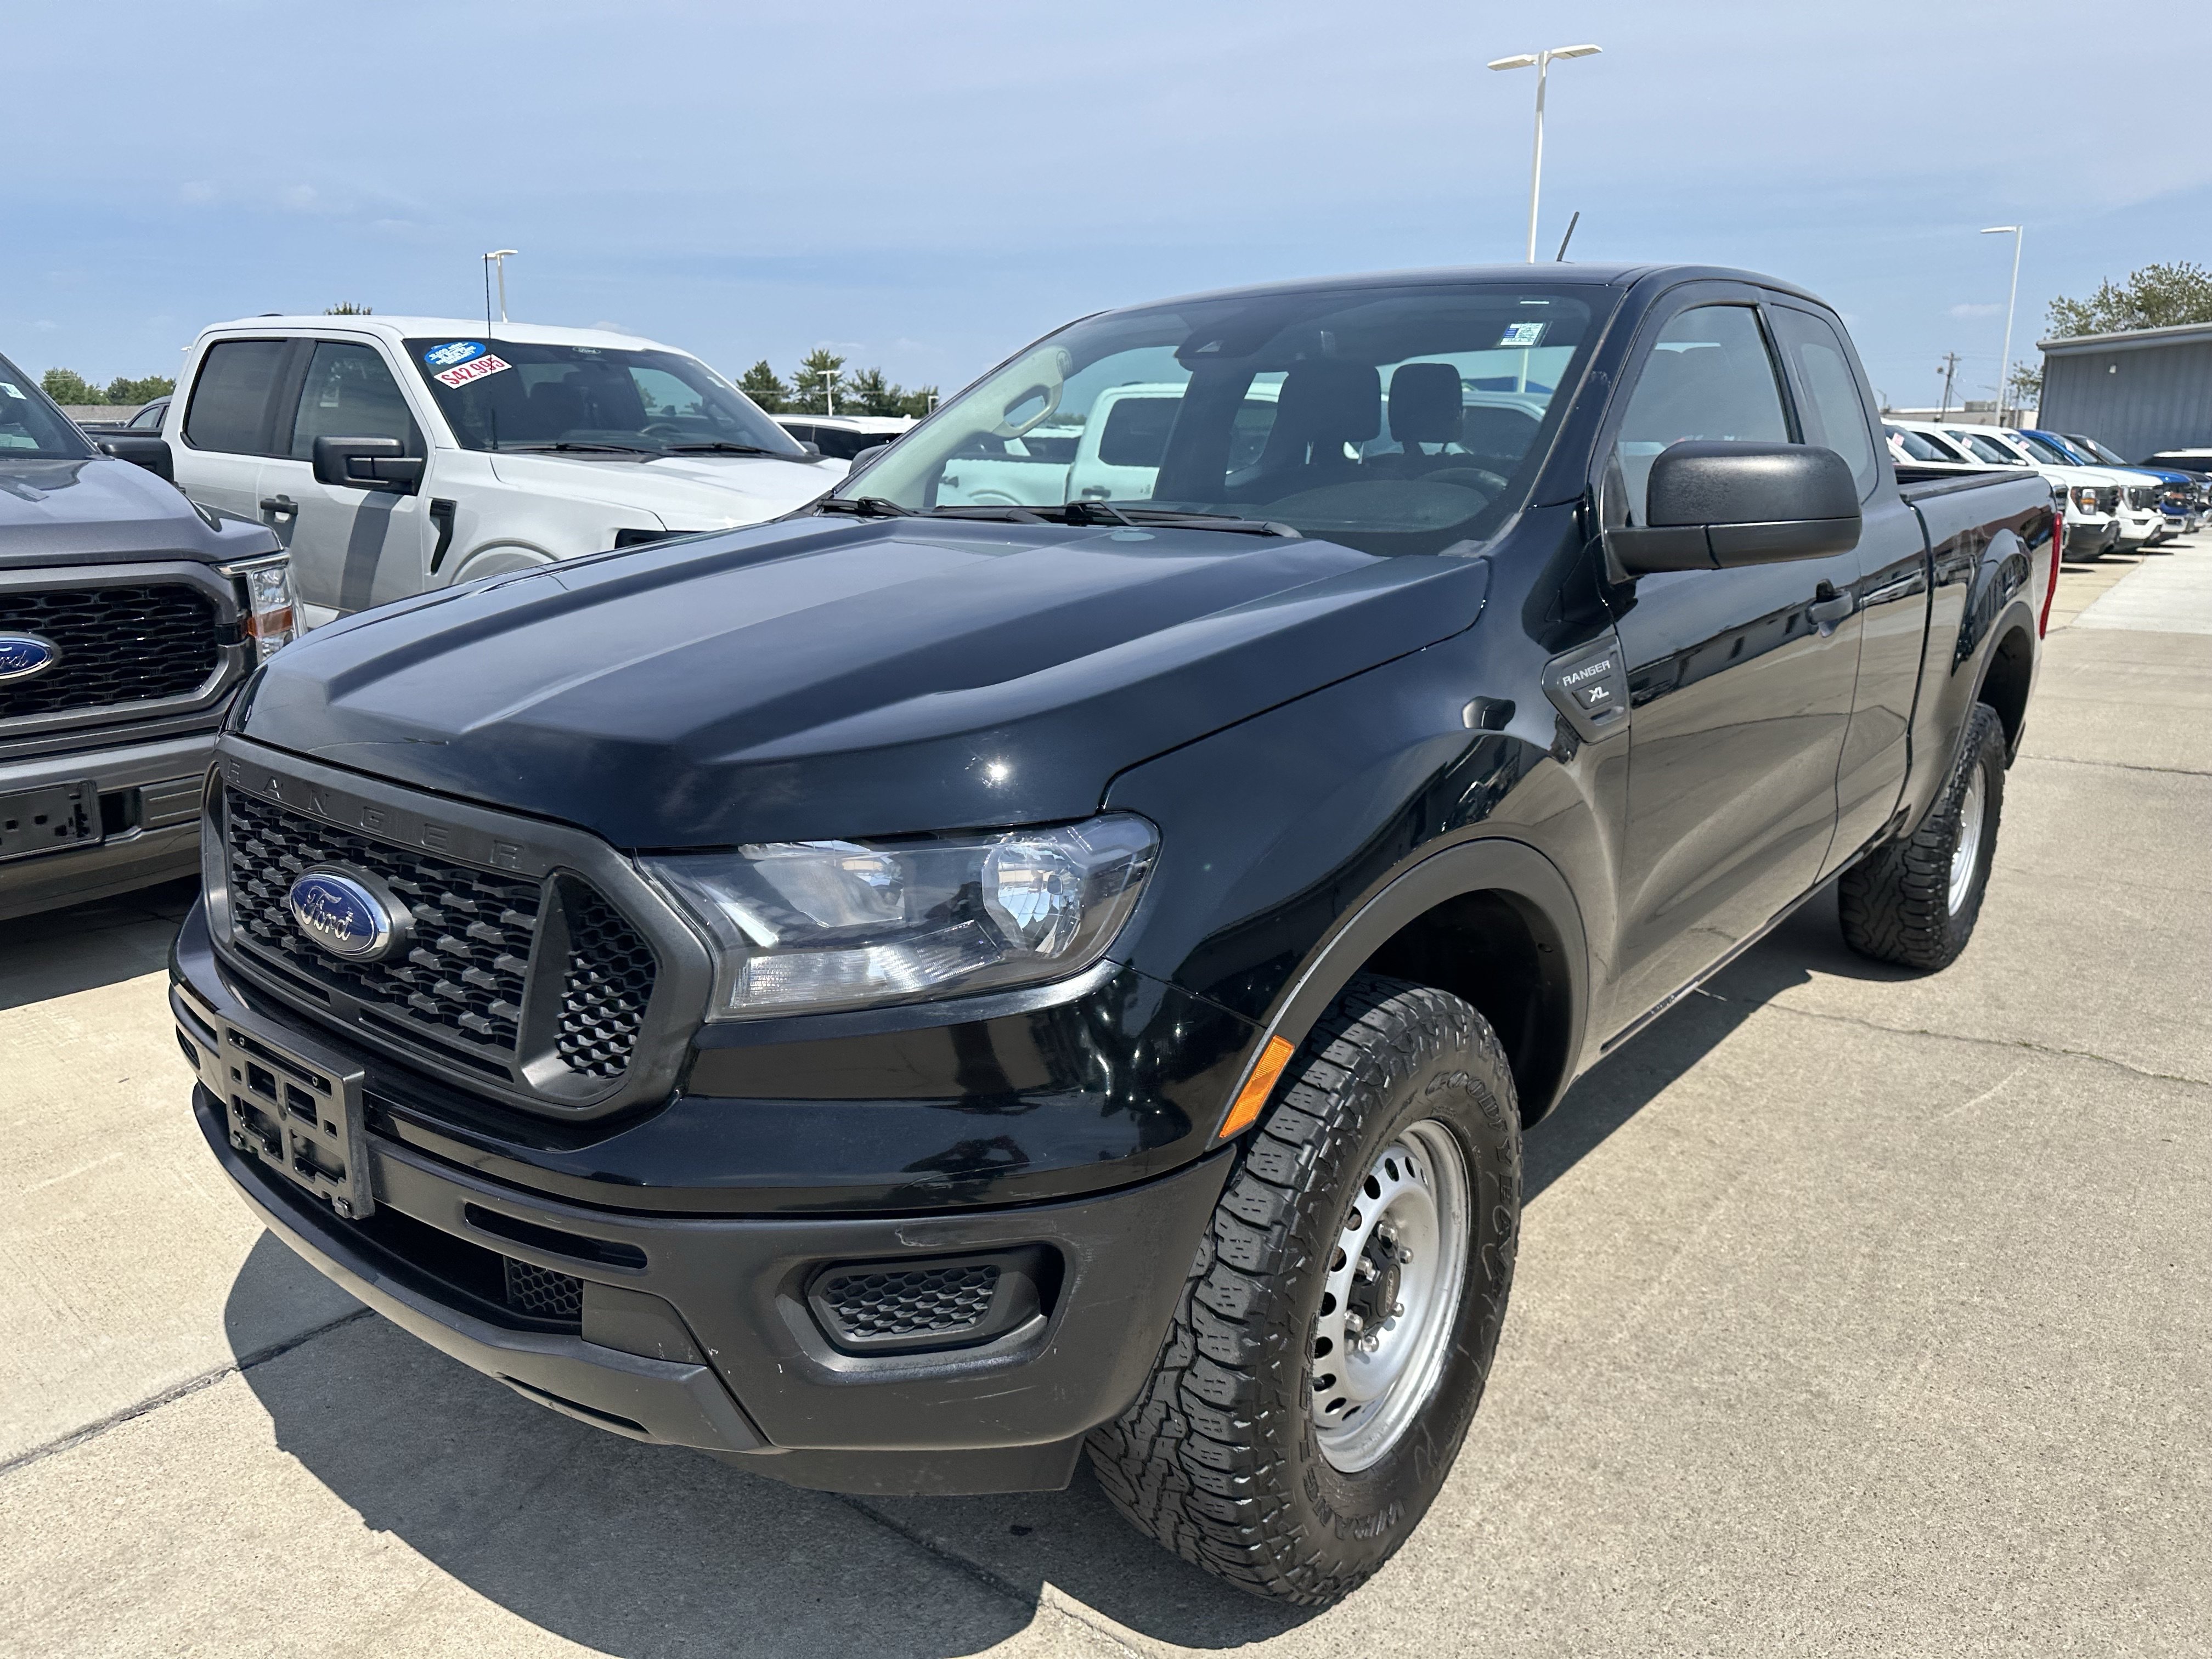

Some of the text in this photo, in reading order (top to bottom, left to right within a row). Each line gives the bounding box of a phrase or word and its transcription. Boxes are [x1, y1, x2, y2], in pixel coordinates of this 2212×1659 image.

[441, 357, 505, 385] $42,995
[1561, 659, 1611, 687] RANGER
[1588, 686, 1610, 703] XL
[226, 759, 525, 869] RANGER
[300, 885, 354, 942] Ford
[1425, 1070, 1513, 1299] GOODYEAR
